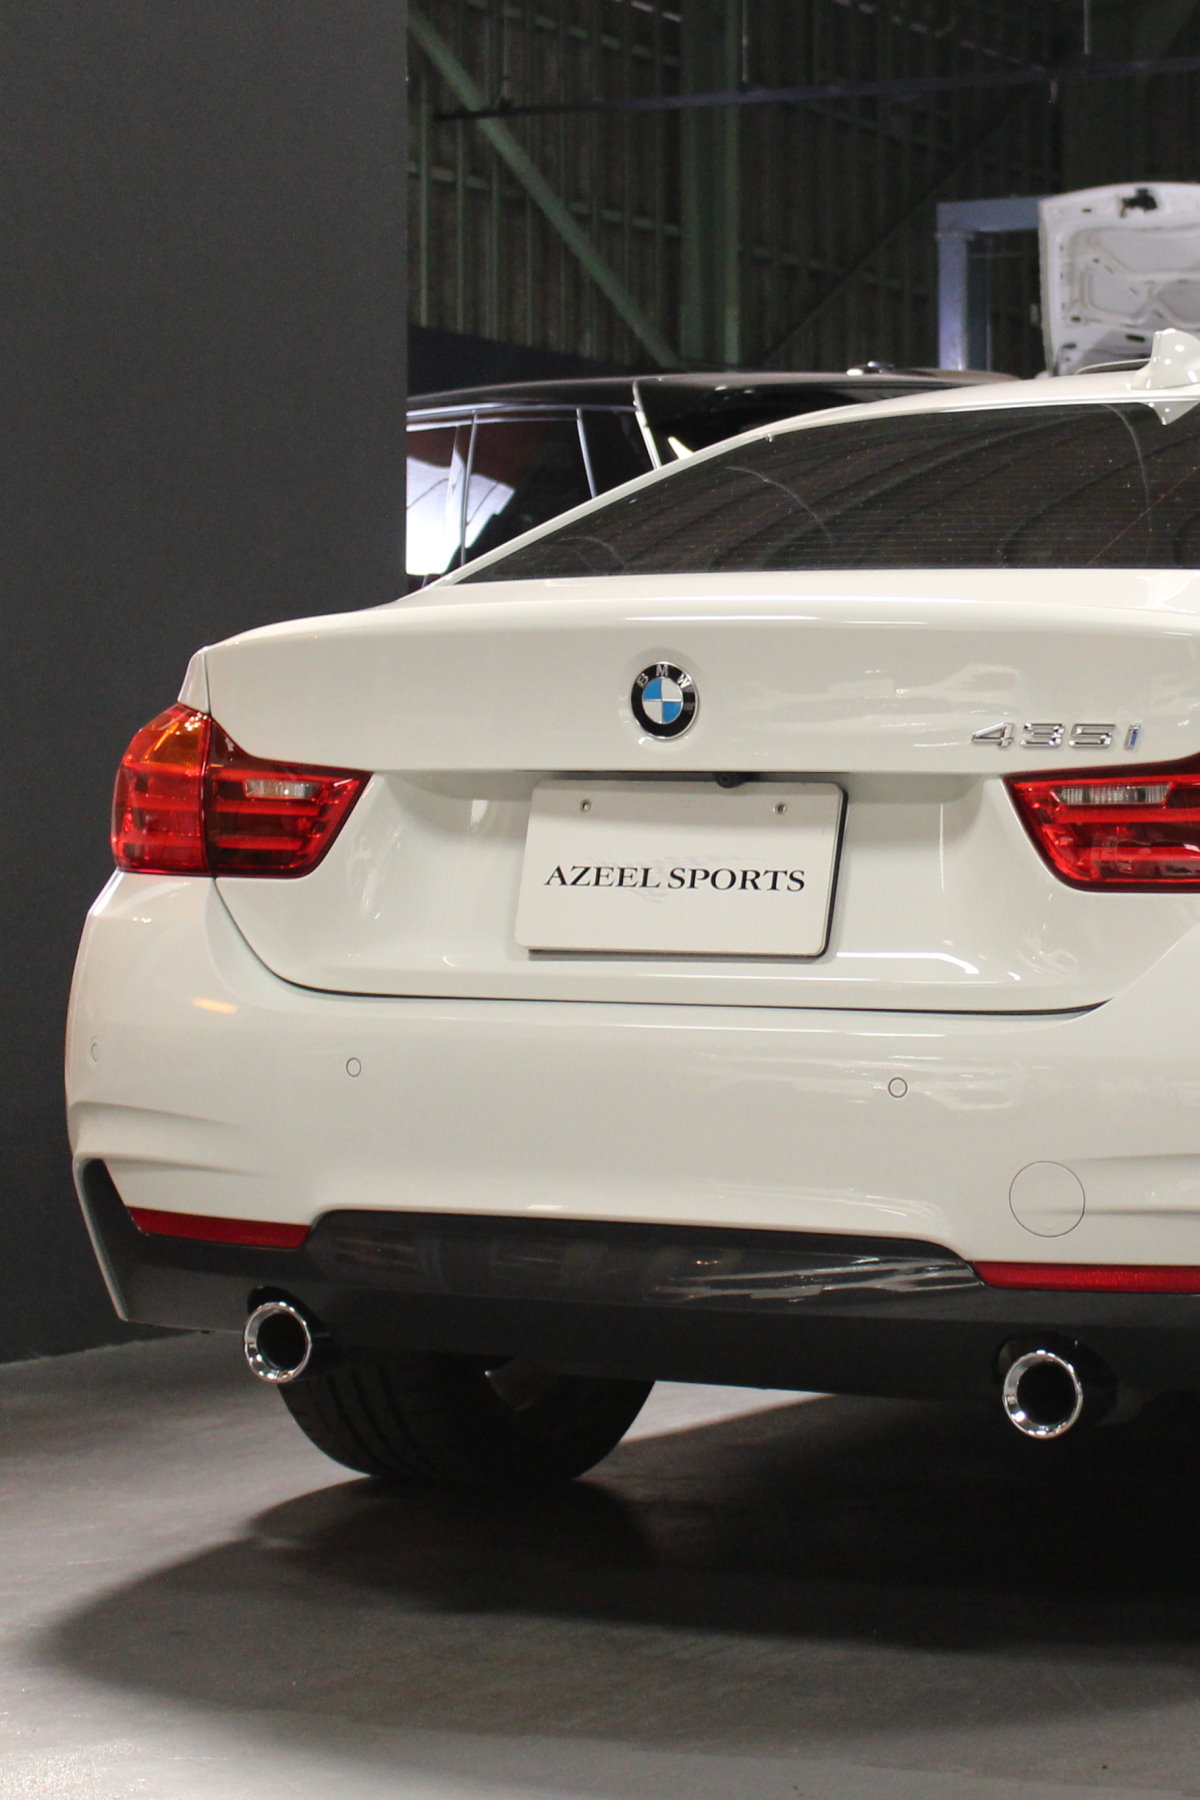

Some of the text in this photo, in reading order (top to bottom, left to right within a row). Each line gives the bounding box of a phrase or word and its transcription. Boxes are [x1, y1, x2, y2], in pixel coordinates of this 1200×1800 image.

[635, 663, 692, 688] BMW
[971, 721, 1143, 750] 435i
[544, 865, 806, 892] AZEEL SPORTS
